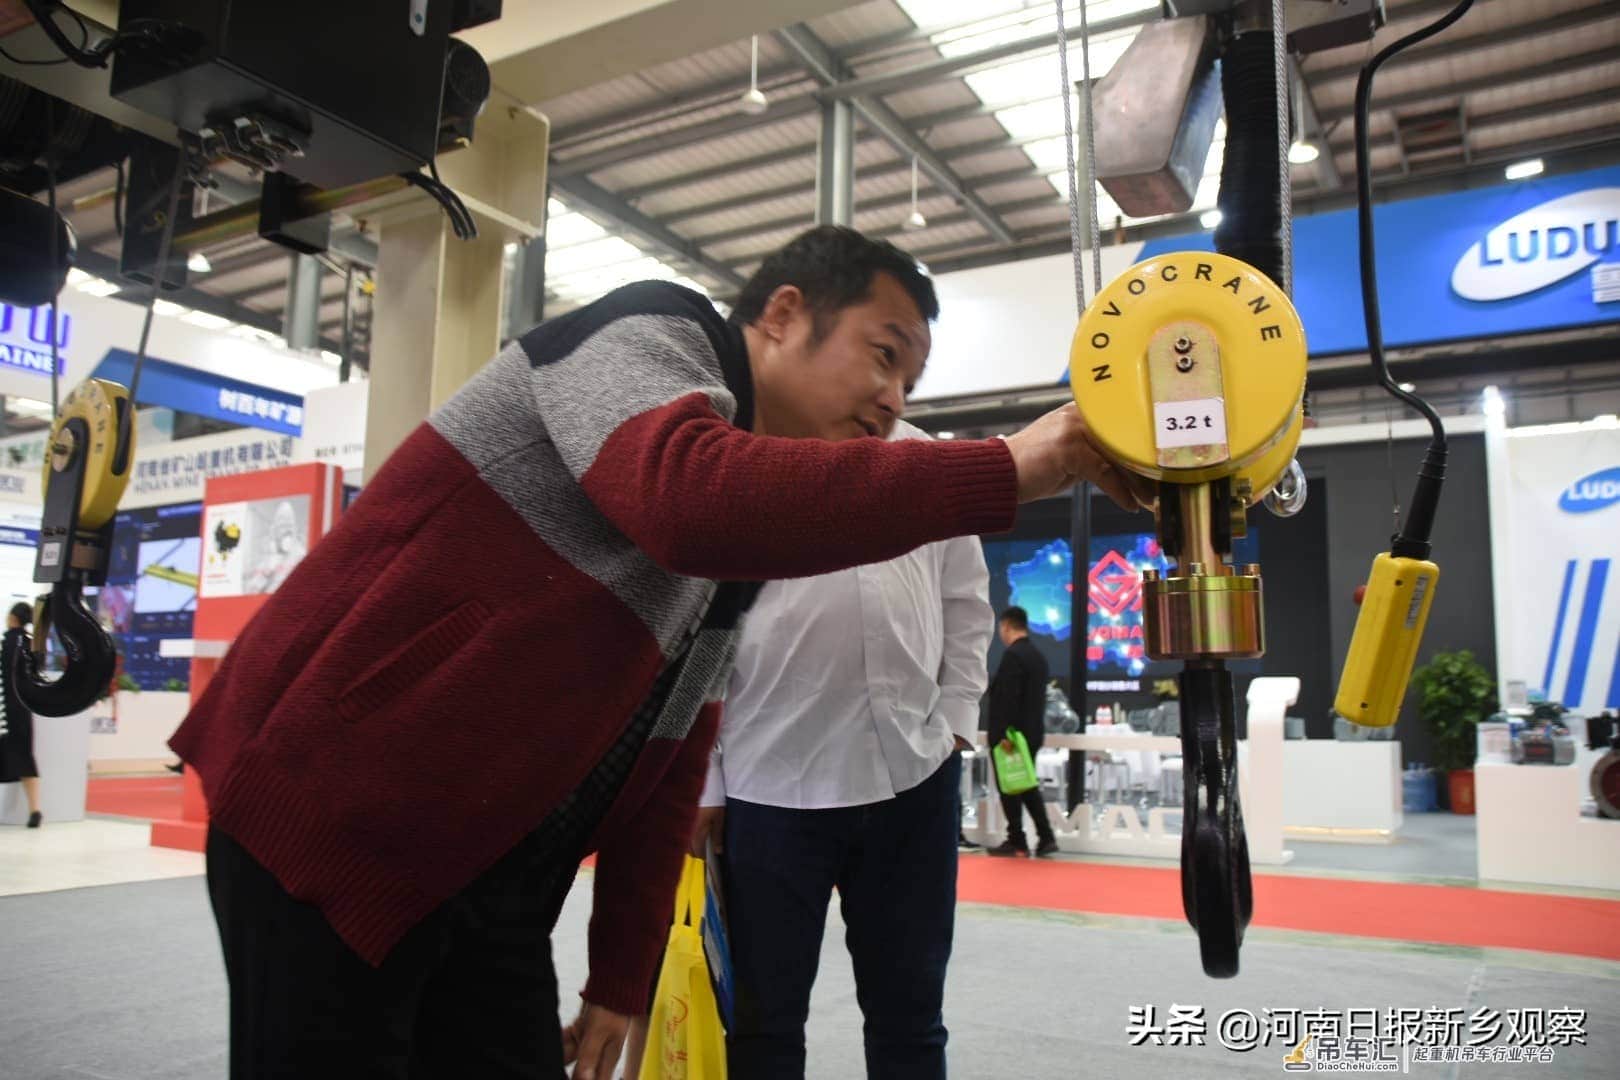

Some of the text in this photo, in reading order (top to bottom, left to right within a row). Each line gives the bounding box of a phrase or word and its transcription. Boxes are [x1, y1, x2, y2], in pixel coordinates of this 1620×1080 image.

[1480, 221, 1620, 266] LUDU
[1092, 263, 1282, 383] NOVOCRANE
[1166, 414, 1213, 431] 3.2 t
